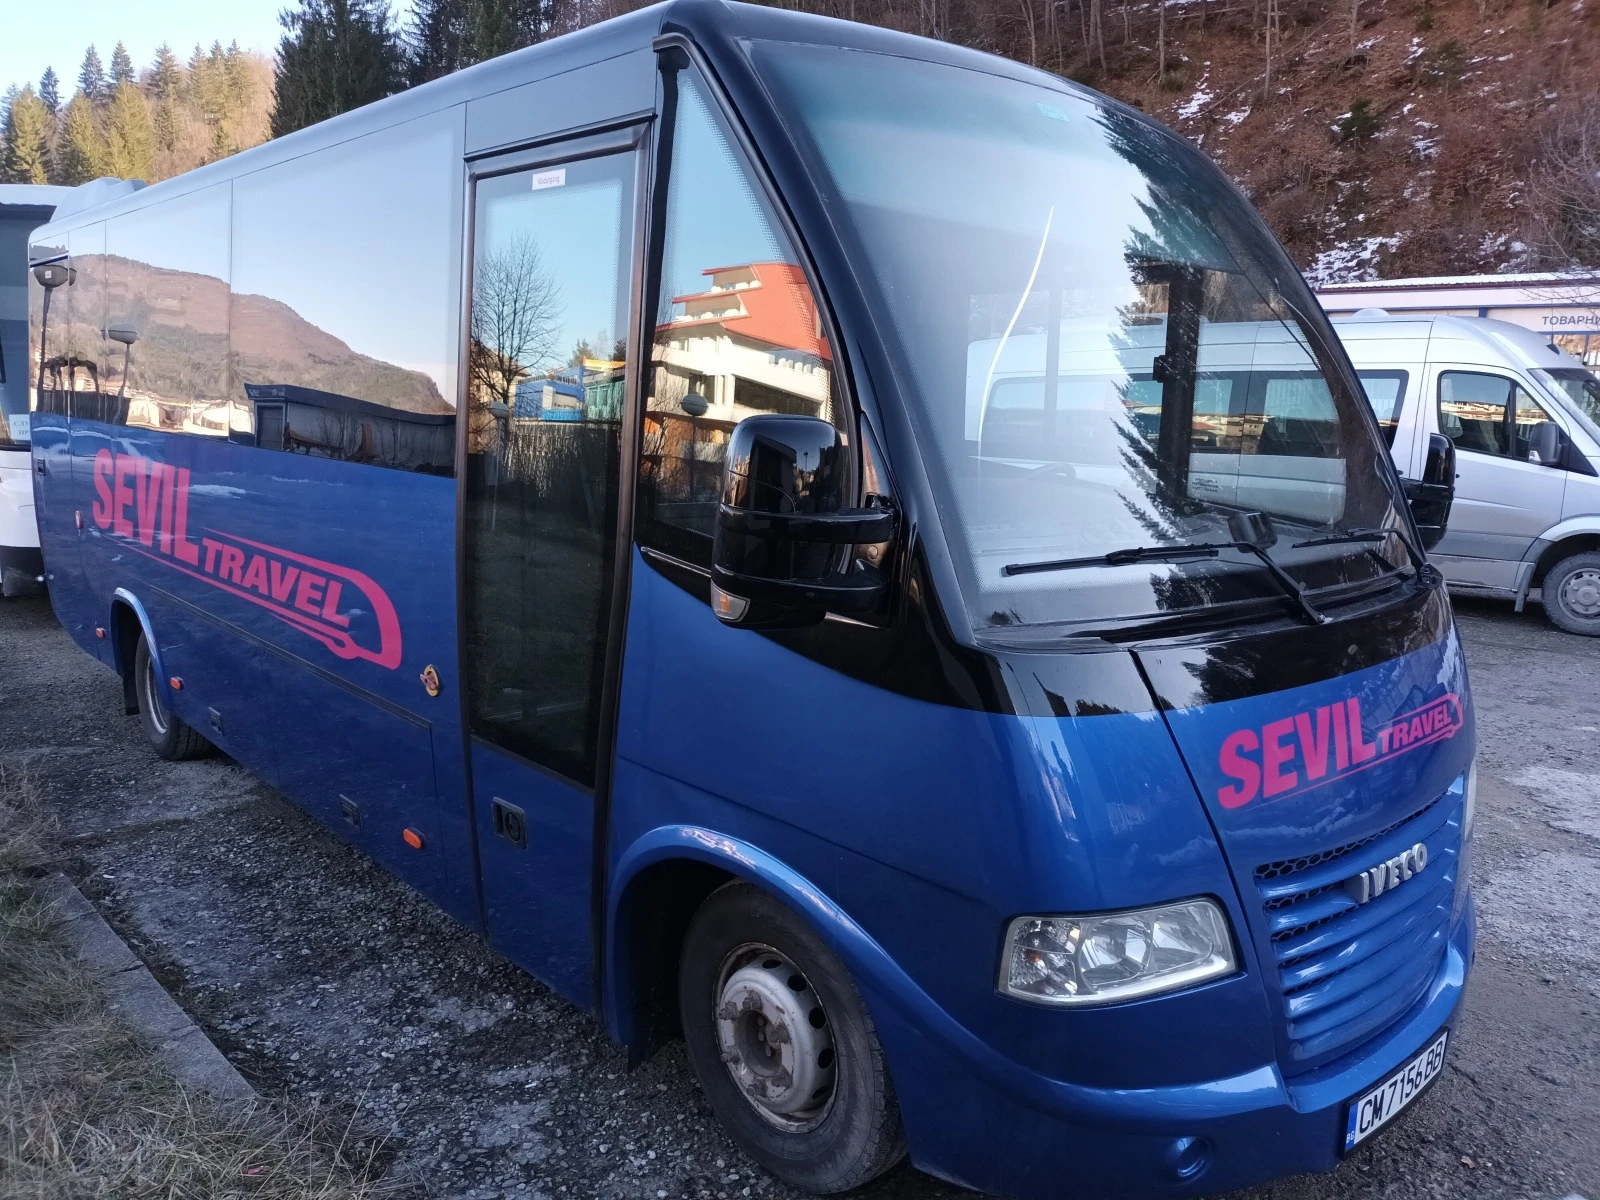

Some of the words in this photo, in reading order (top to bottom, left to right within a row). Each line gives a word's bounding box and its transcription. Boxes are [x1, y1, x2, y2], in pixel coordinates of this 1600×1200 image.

[92, 448, 199, 567] SEVIL
[202, 538, 350, 628] TRAVEL
[1217, 696, 1376, 809] SEVIL
[1377, 703, 1453, 755] TRAVEL
[1352, 842, 1428, 904] IVECO
